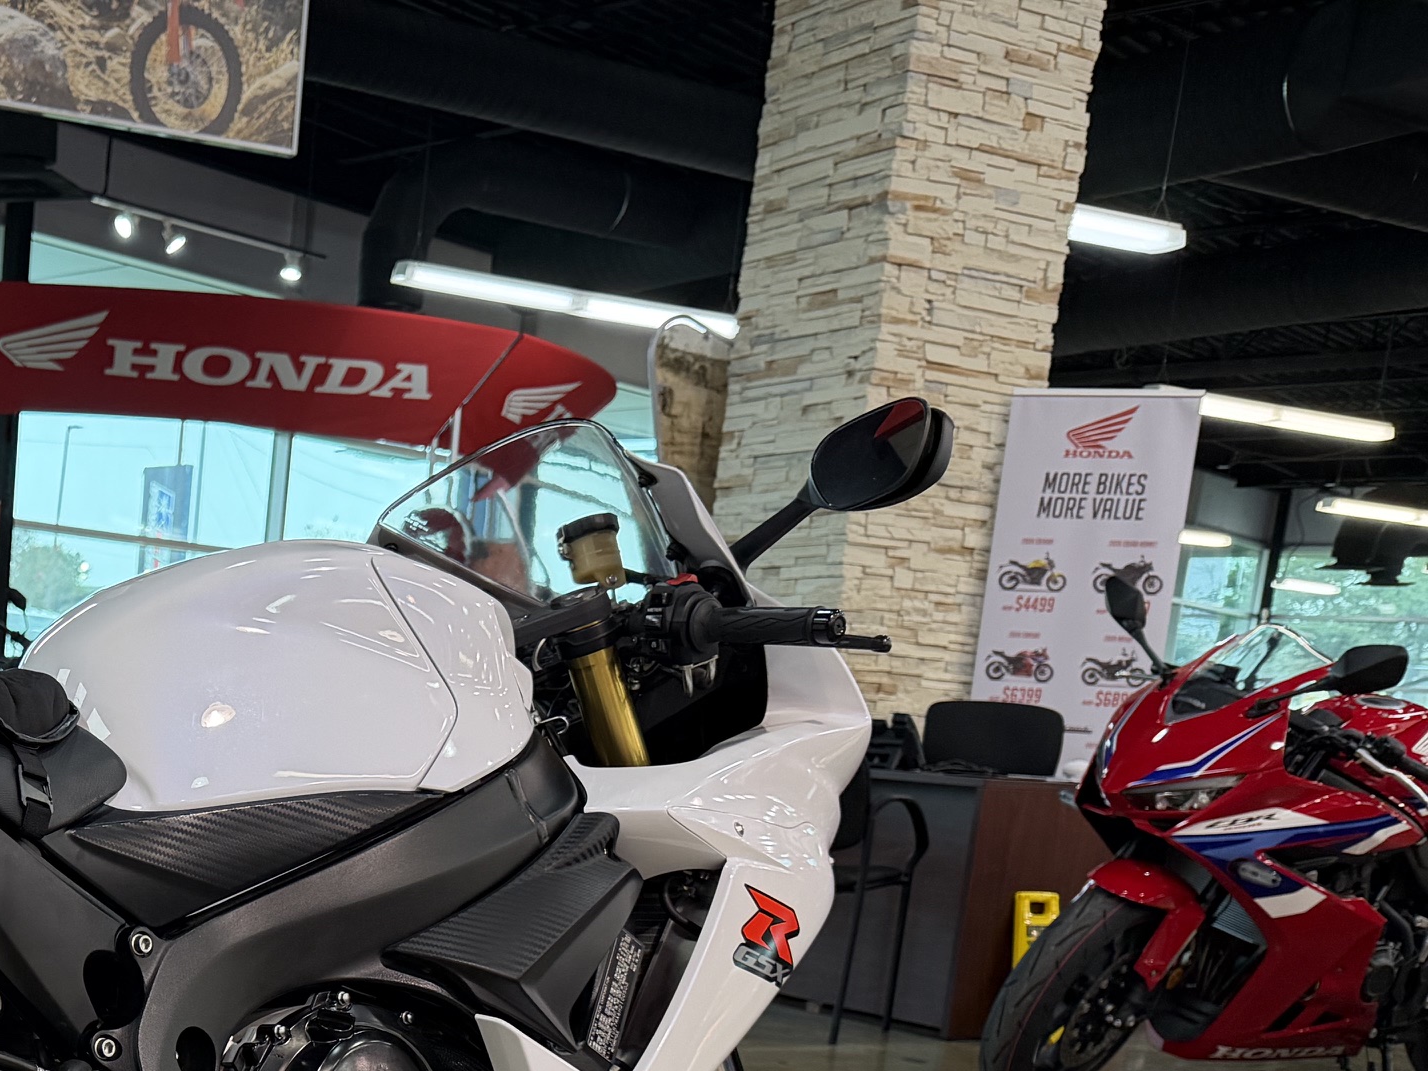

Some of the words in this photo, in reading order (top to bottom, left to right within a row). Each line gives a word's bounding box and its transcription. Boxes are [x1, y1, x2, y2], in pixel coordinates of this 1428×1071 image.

[104, 338, 433, 401] HONDA
[1063, 449, 1134, 460] HONDA
[1042, 472, 1093, 495] MORE
[1096, 472, 1148, 496] BIKES
[1036, 496, 1088, 519] MORE
[1092, 497, 1147, 521] VALUE
[1014, 595, 1055, 613] $4499
[1002, 686, 1043, 703] $6399
[1094, 689, 1131, 708] $689
[733, 942, 792, 988] GSX
[1209, 1044, 1348, 1060] HONDA
